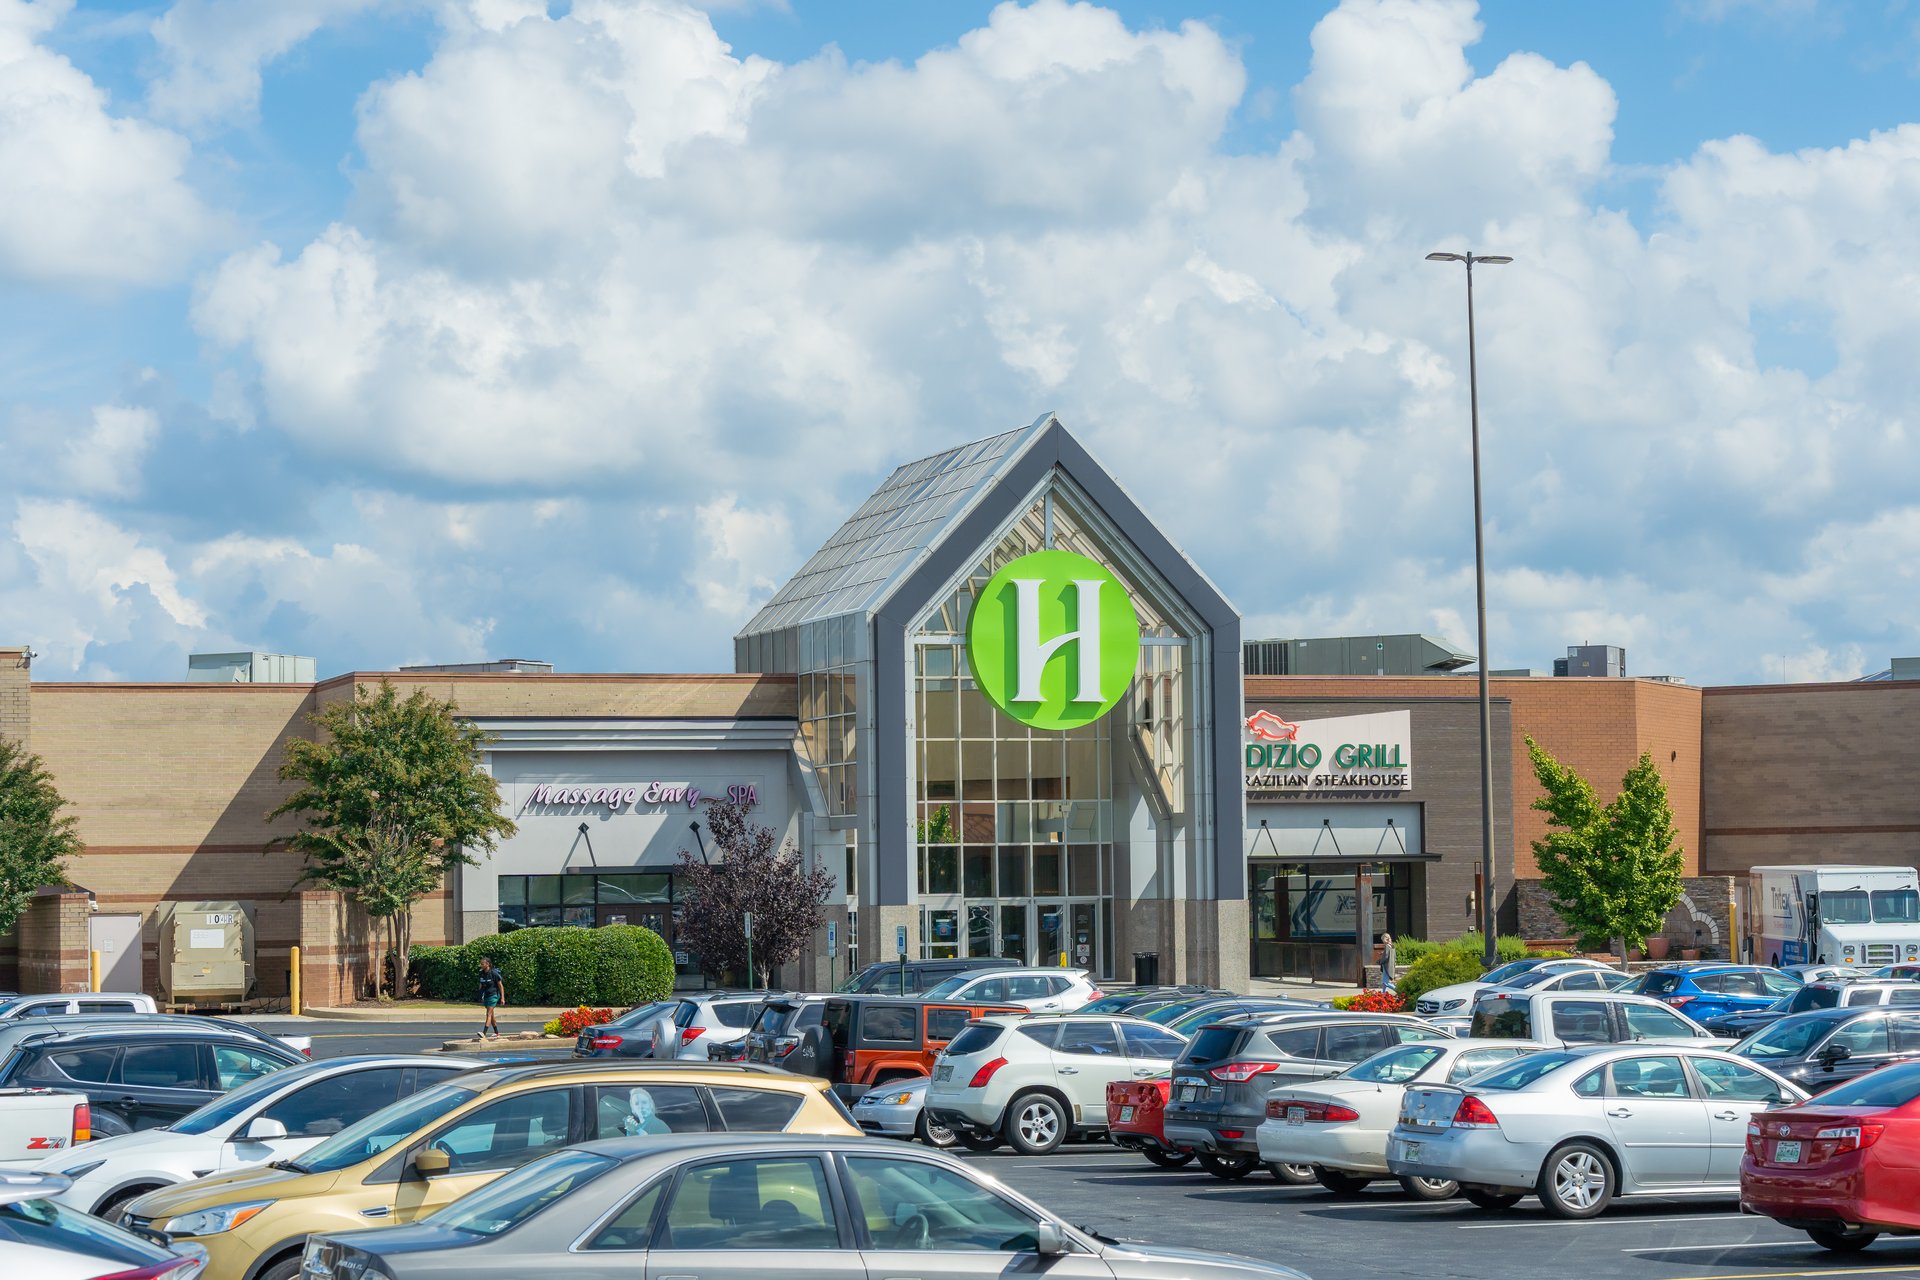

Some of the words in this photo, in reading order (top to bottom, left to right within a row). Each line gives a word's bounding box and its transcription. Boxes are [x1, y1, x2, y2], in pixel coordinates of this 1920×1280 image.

[1010, 578, 1108, 703] H
[1246, 743, 1322, 769] DIZIO
[1335, 743, 1408, 769] GRILL
[1315, 774, 1408, 787] STEAKHOUSE
[524, 782, 636, 810] Massage
[643, 781, 701, 809] Envy
[26, 1136, 67, 1150] Z71
